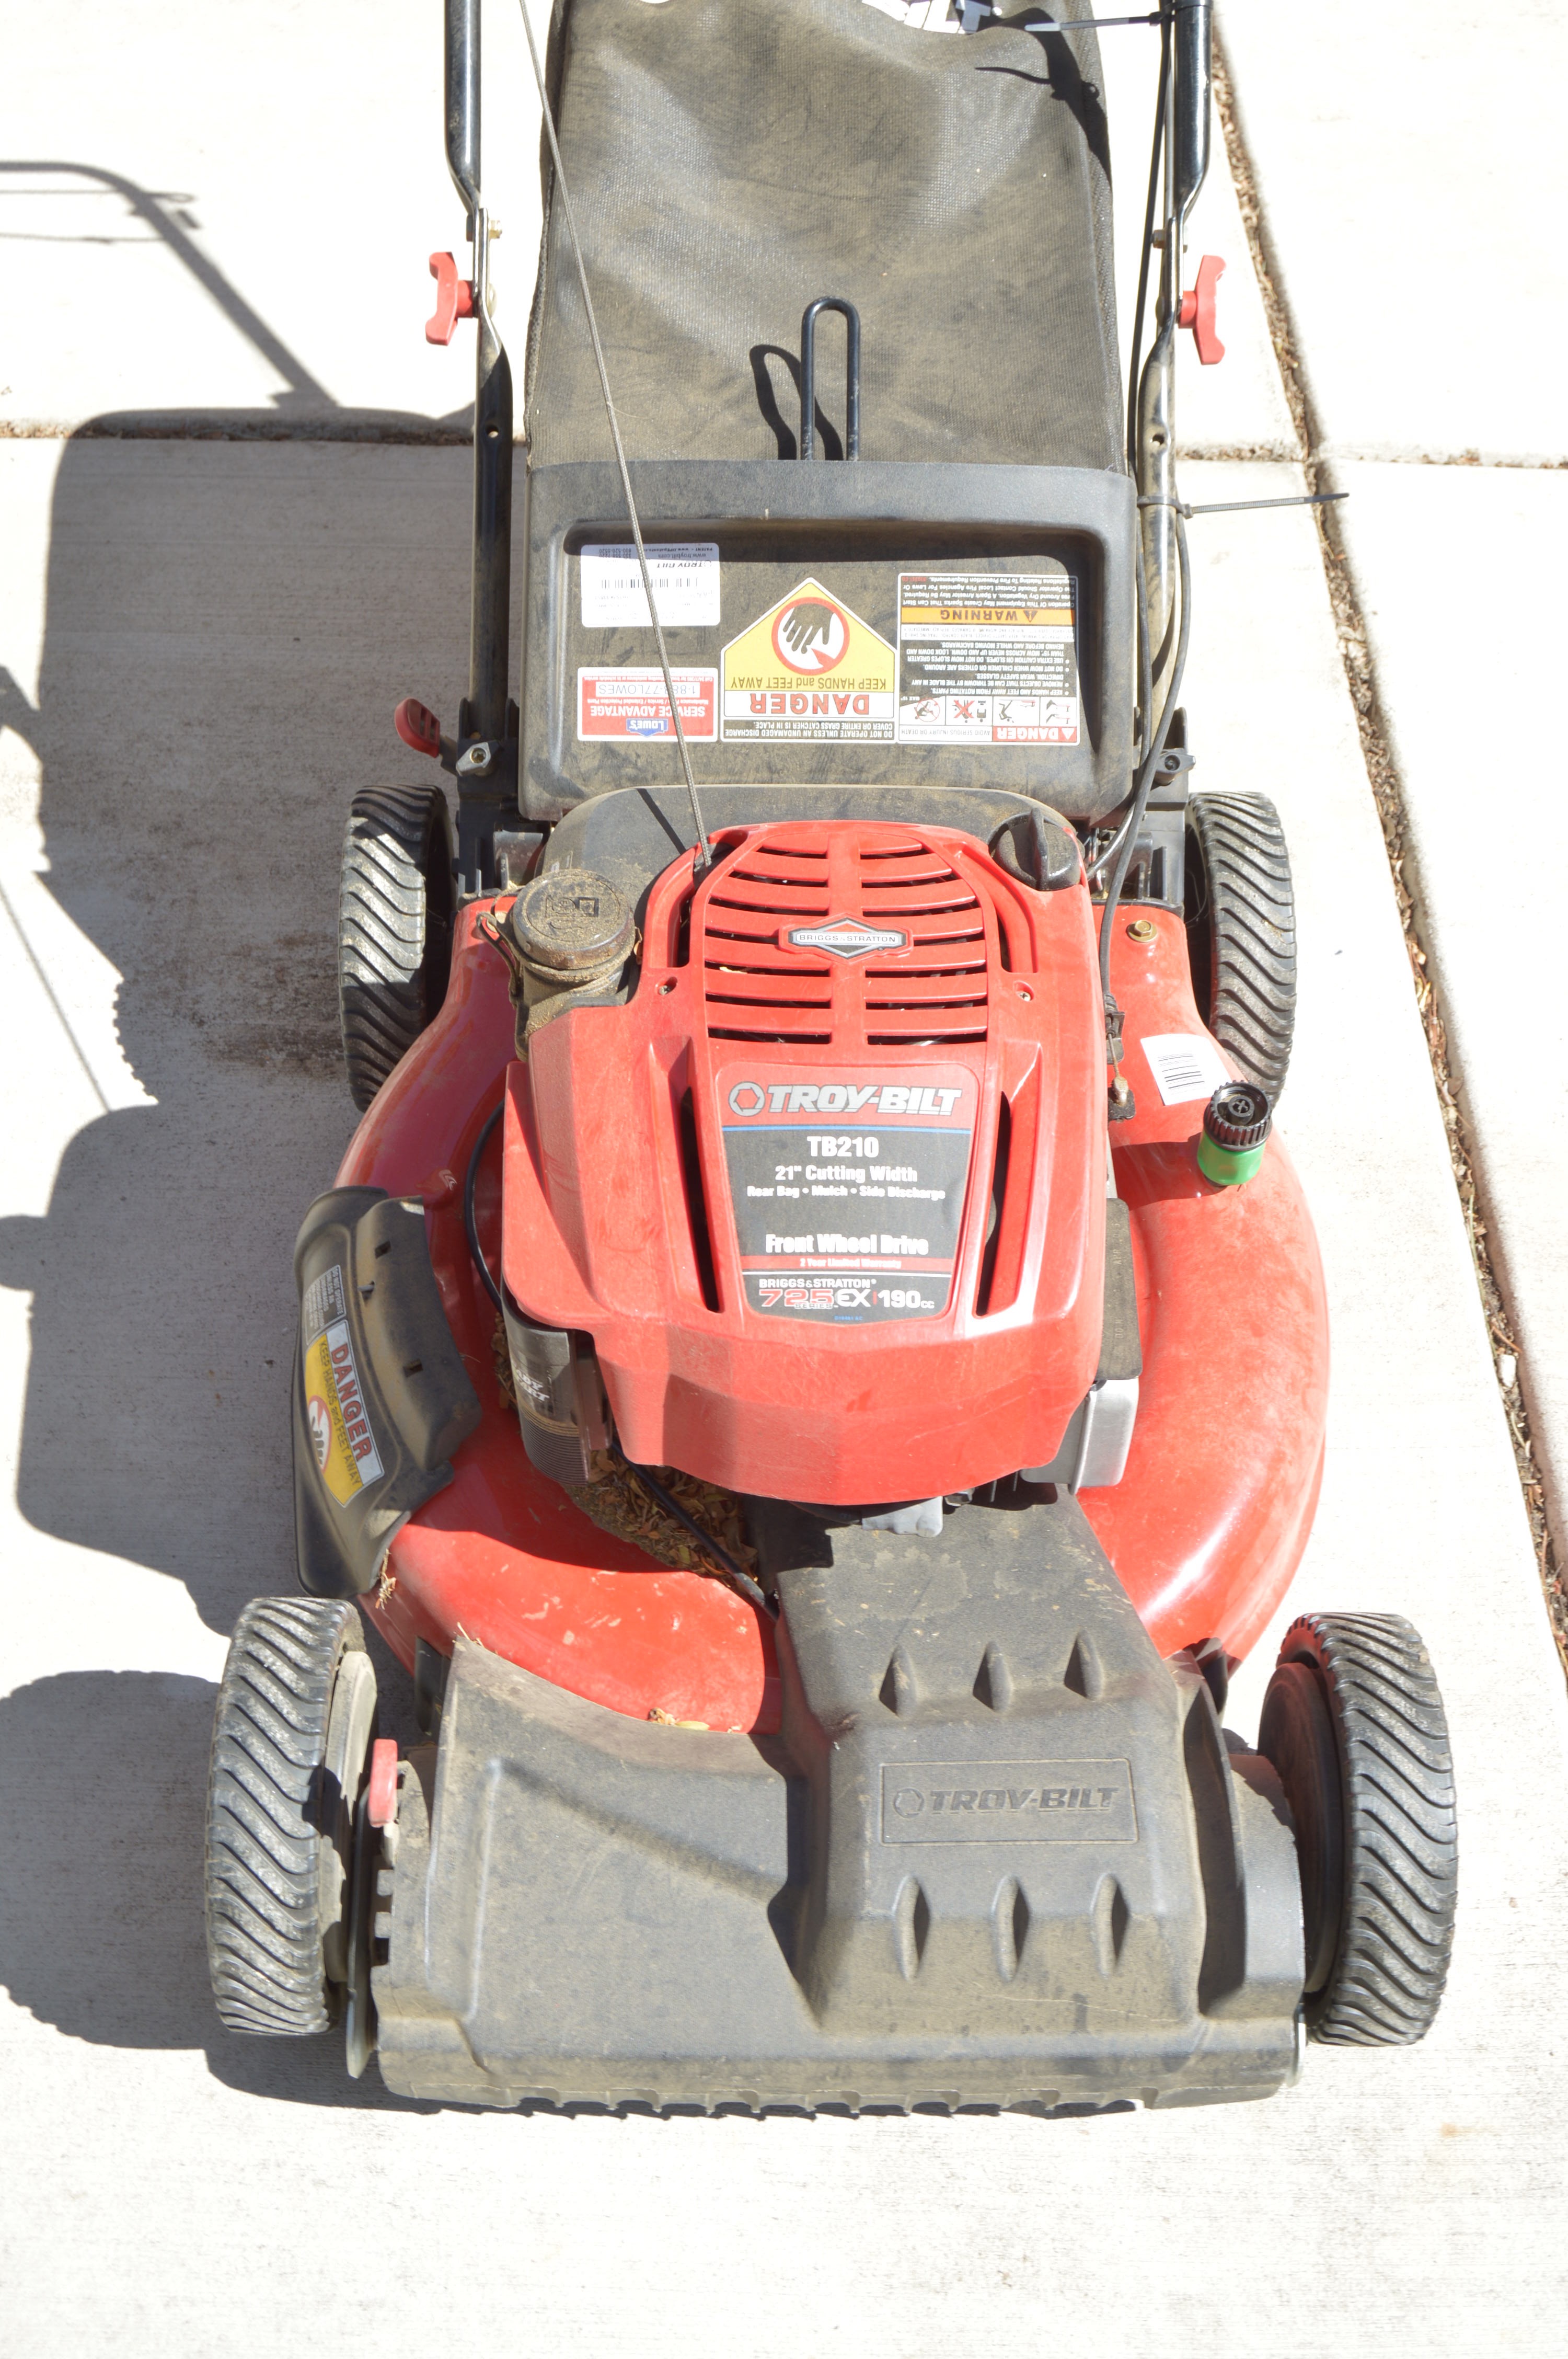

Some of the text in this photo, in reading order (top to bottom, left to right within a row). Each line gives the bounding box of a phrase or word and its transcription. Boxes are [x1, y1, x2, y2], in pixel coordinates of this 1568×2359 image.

[940, 610, 1018, 621] WARNING
[731, 677, 886, 690] KEEP HANDS and FEET AWAY
[590, 705, 705, 717] SERVCE ADVANTAGE
[750, 693, 869, 715] DANGER
[997, 728, 1058, 740] DANGER
[767, 1084, 962, 1116] TROY-BILT
[806, 1136, 879, 1158] TB210
[775, 1165, 918, 1183] 21" Cutting Width
[747, 1185, 946, 1201] Rear Bag Mulch Side Discharge
[766, 1234, 929, 1255] Front Wheel Drive
[800, 1258, 902, 1269] 2 Year Limited Warranty
[331, 1342, 372, 1462] DANGER
[319, 1340, 361, 1485] KEEP HANDS and FEET AWAY
[929, 1787, 1120, 1813] TROY-BILT
